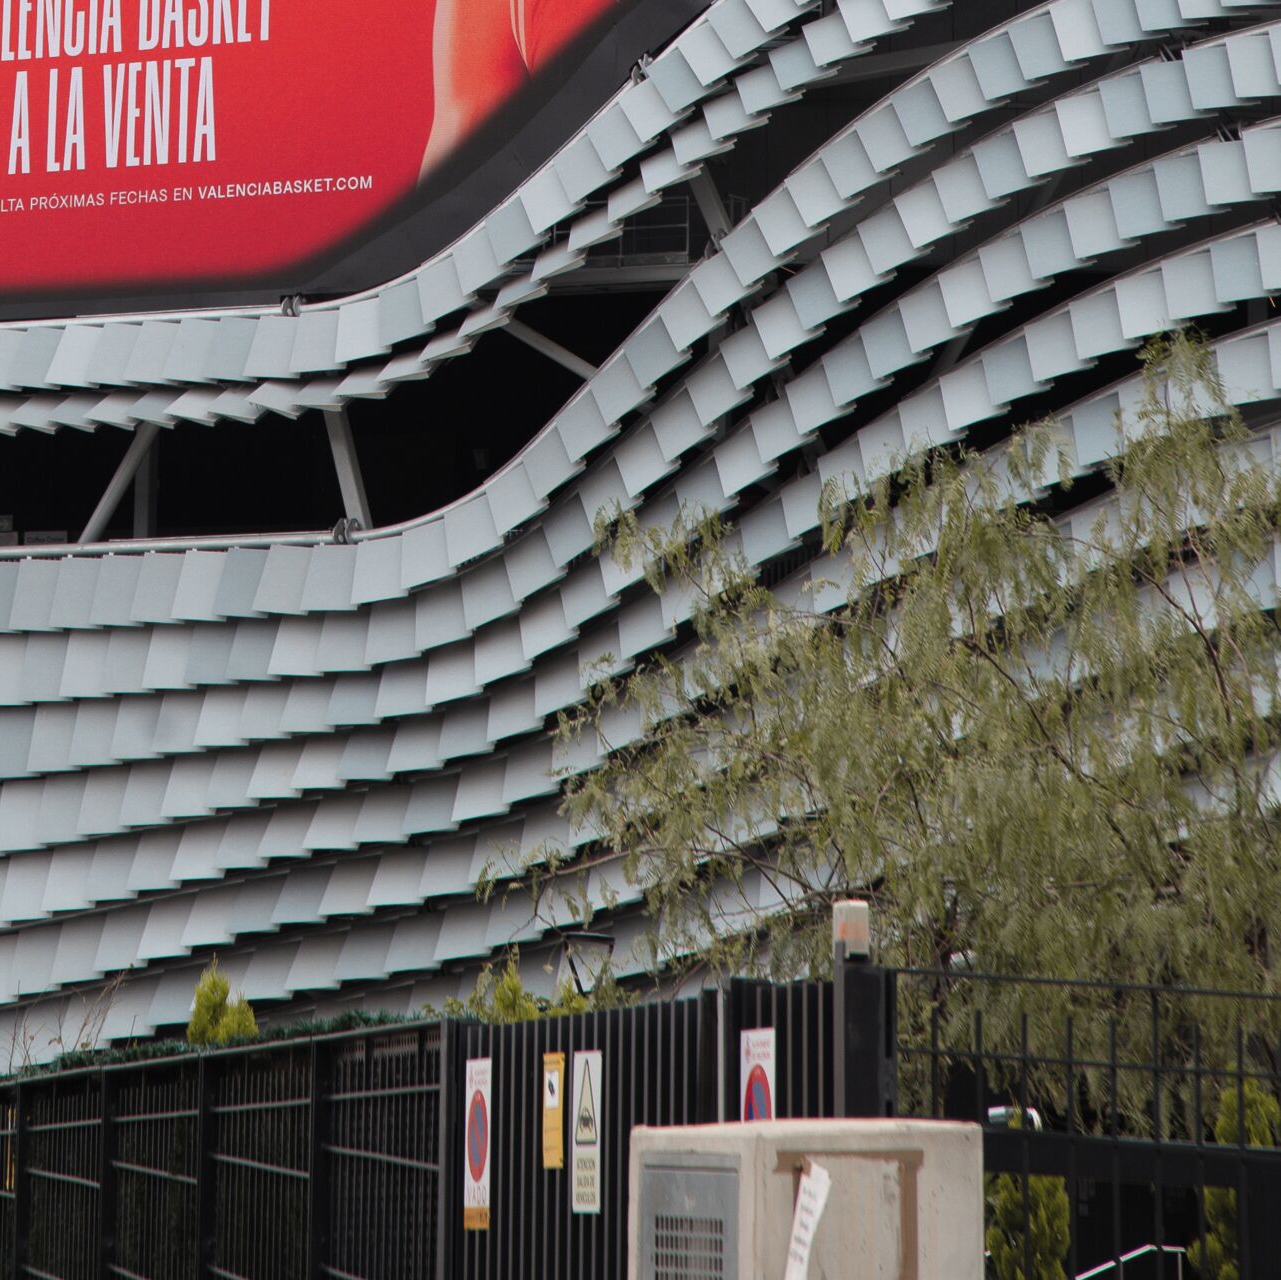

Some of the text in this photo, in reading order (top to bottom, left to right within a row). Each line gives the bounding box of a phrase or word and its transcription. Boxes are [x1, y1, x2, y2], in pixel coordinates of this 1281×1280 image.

[7, 70, 31, 175] A
[46, 66, 86, 173] LA
[103, 56, 216, 169] VENTA
[29, 192, 105, 210] PRÓXIMAS
[109, 188, 168, 206] FECHAS
[173, 187, 193, 202] EN
[197, 175, 373, 200] VALENCIABASKET.COM
[467, 1184, 487, 1206] VADO
